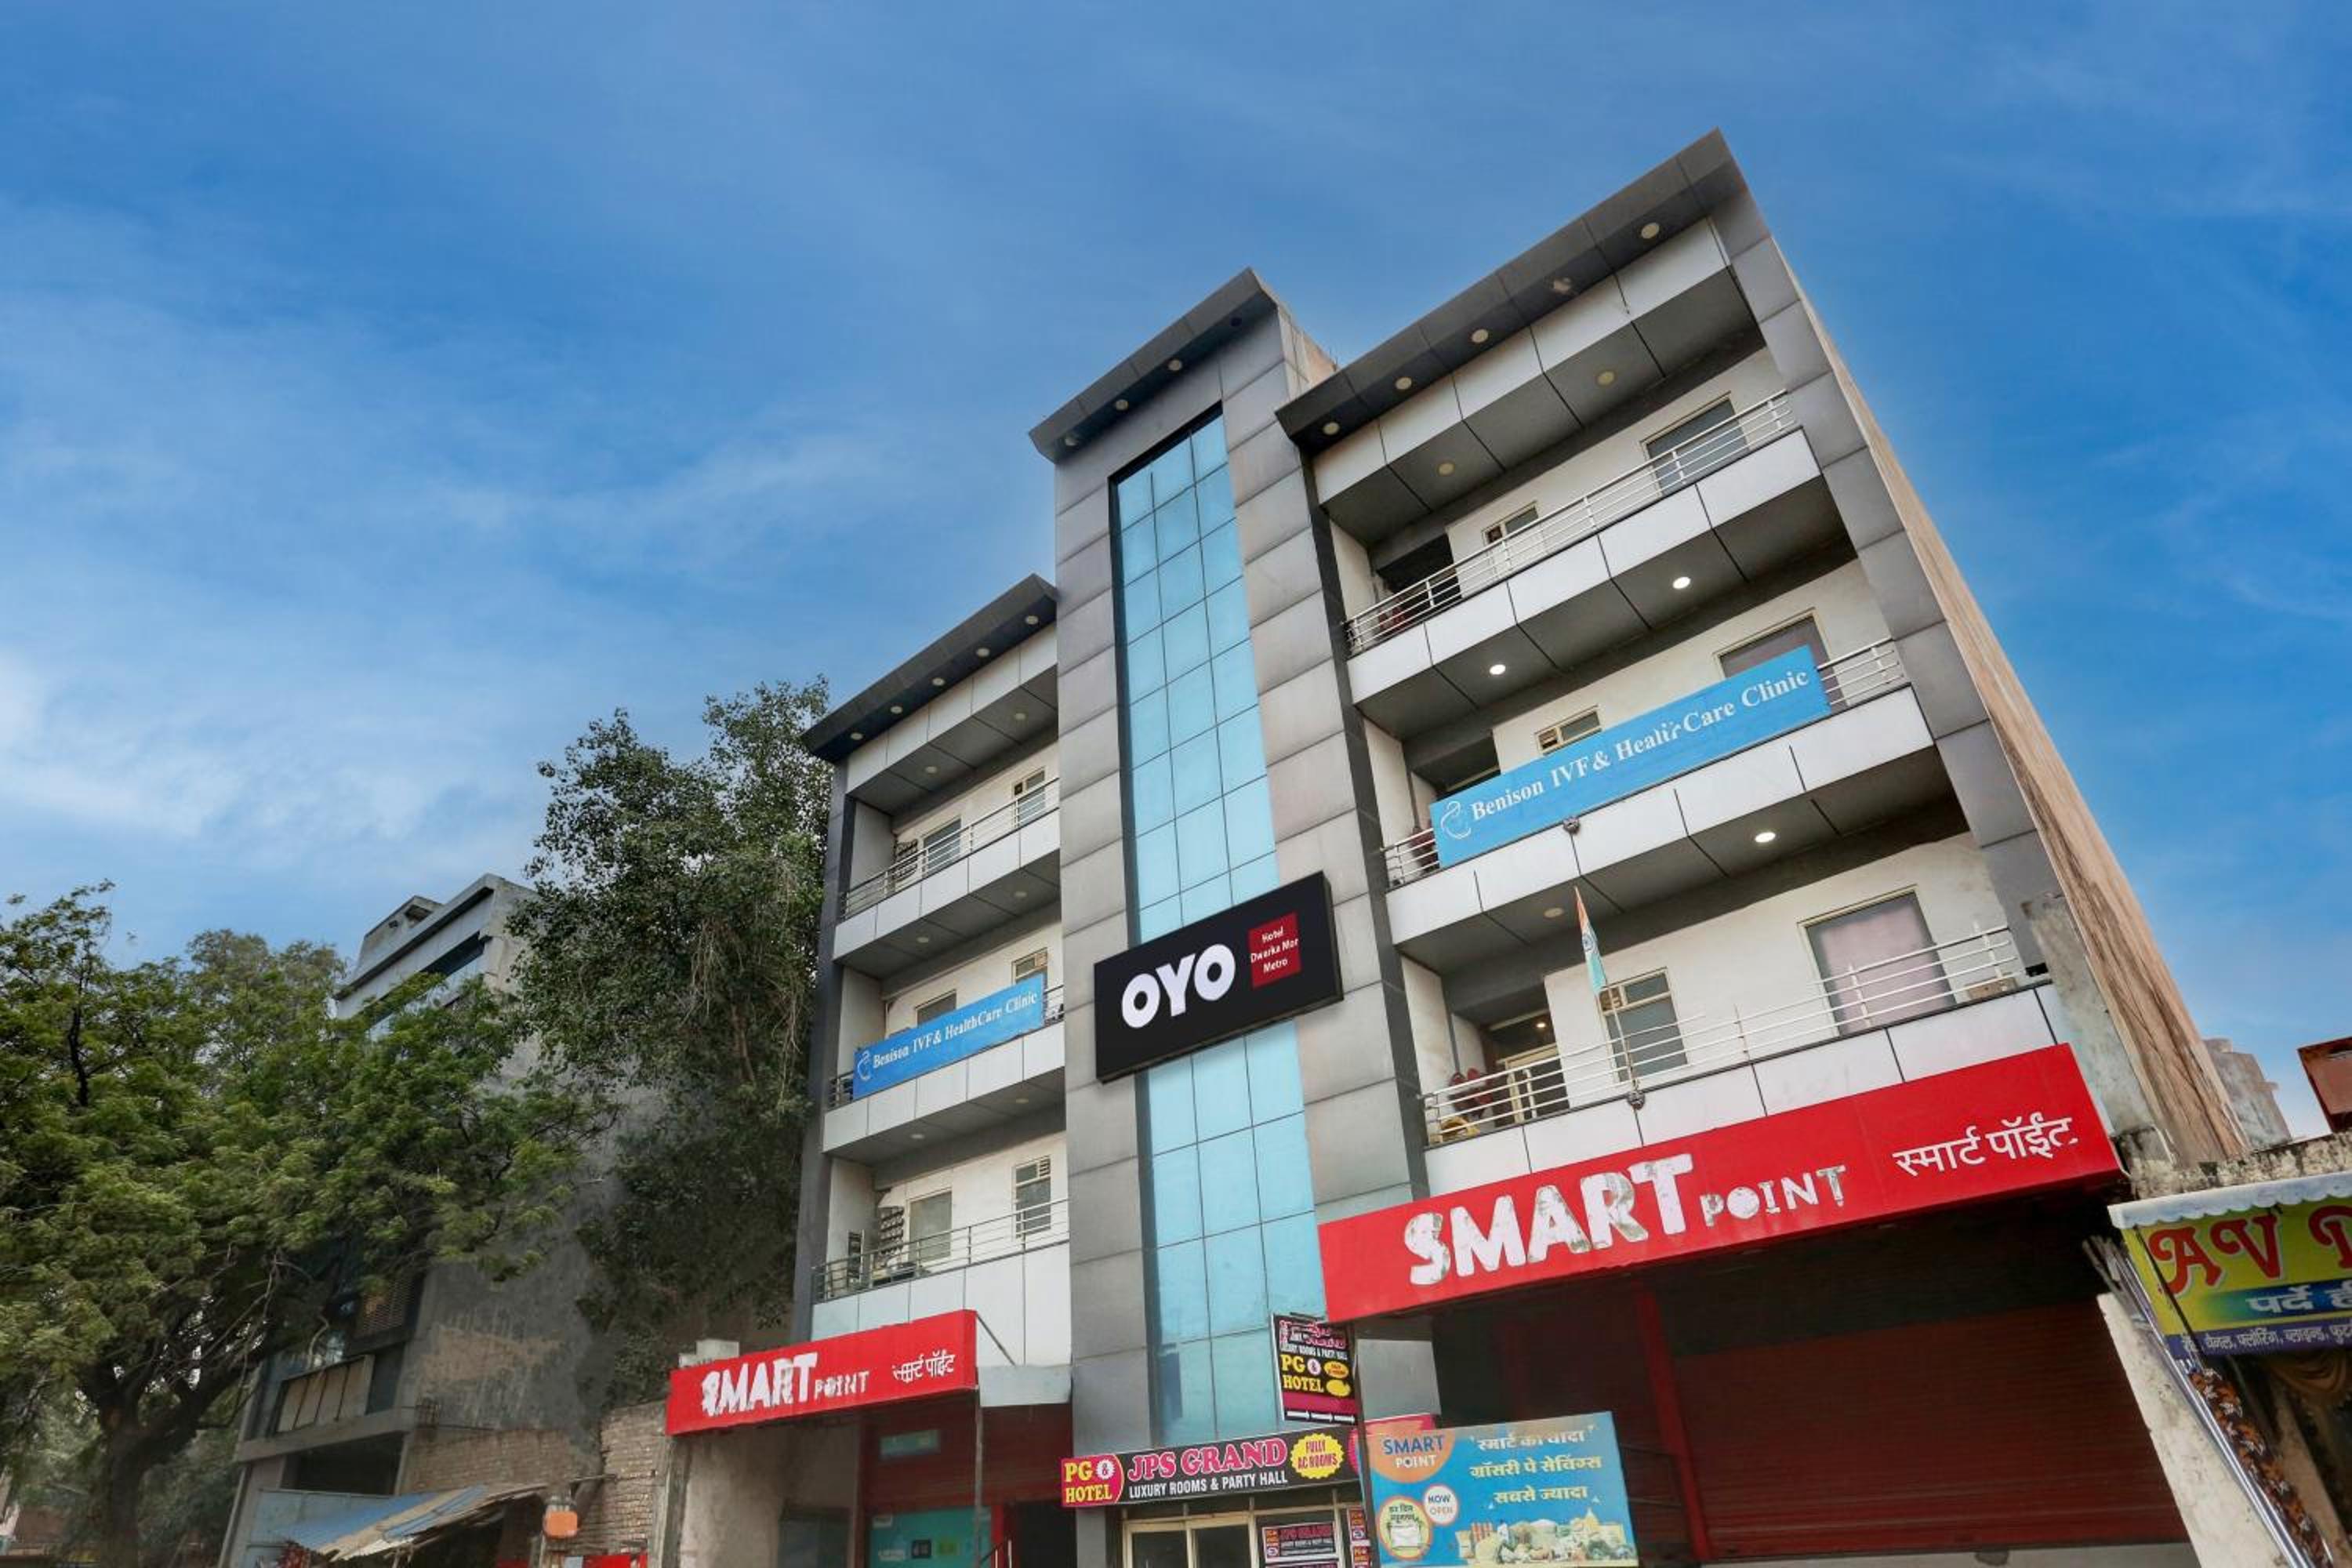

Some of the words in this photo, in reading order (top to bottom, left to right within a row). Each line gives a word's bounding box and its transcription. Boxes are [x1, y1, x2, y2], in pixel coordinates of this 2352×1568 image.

[1470, 778, 1544, 822] Benison
[1740, 669, 1809, 708] Clinic
[1261, 926, 1283, 943] Hotel
[1250, 946, 1280, 964] Dwarka
[1263, 958, 1288, 974] Metro
[1122, 943, 1236, 1029] OYO
[873, 1045, 909, 1068] Benison
[1005, 989, 1039, 1014] Clinic
[1892, 1125, 1986, 1177] स्मार्ट
[1404, 1152, 1693, 1286] SMART
[1703, 1164, 1847, 1229] POINT
[2147, 1213, 2281, 1297] AV
[1280, 1354, 1305, 1373] PG
[701, 1352, 818, 1417] SMART
[814, 1371, 870, 1401] POINT
[1282, 1374, 1324, 1393] HOTEL
[1383, 1435, 1445, 1456] SMART
[1127, 1450, 1177, 1481] JPS
[1180, 1437, 1288, 1473] GRAND
[1395, 1454, 1437, 1468] POINT
[1064, 1461, 1093, 1482] PG
[1065, 1483, 1112, 1503] HOTEL
[1129, 1483, 1167, 1499] LUXURY
[1169, 1478, 1207, 1495] ROOMS
[1210, 1478, 1220, 1490] &
[1221, 1473, 1256, 1490] PARTY
[1260, 1469, 1288, 1486] HALL
[1493, 1484, 1536, 1504] सबसे
[1428, 1494, 1451, 1504] NOW
[1429, 1506, 1453, 1515] OPEN
